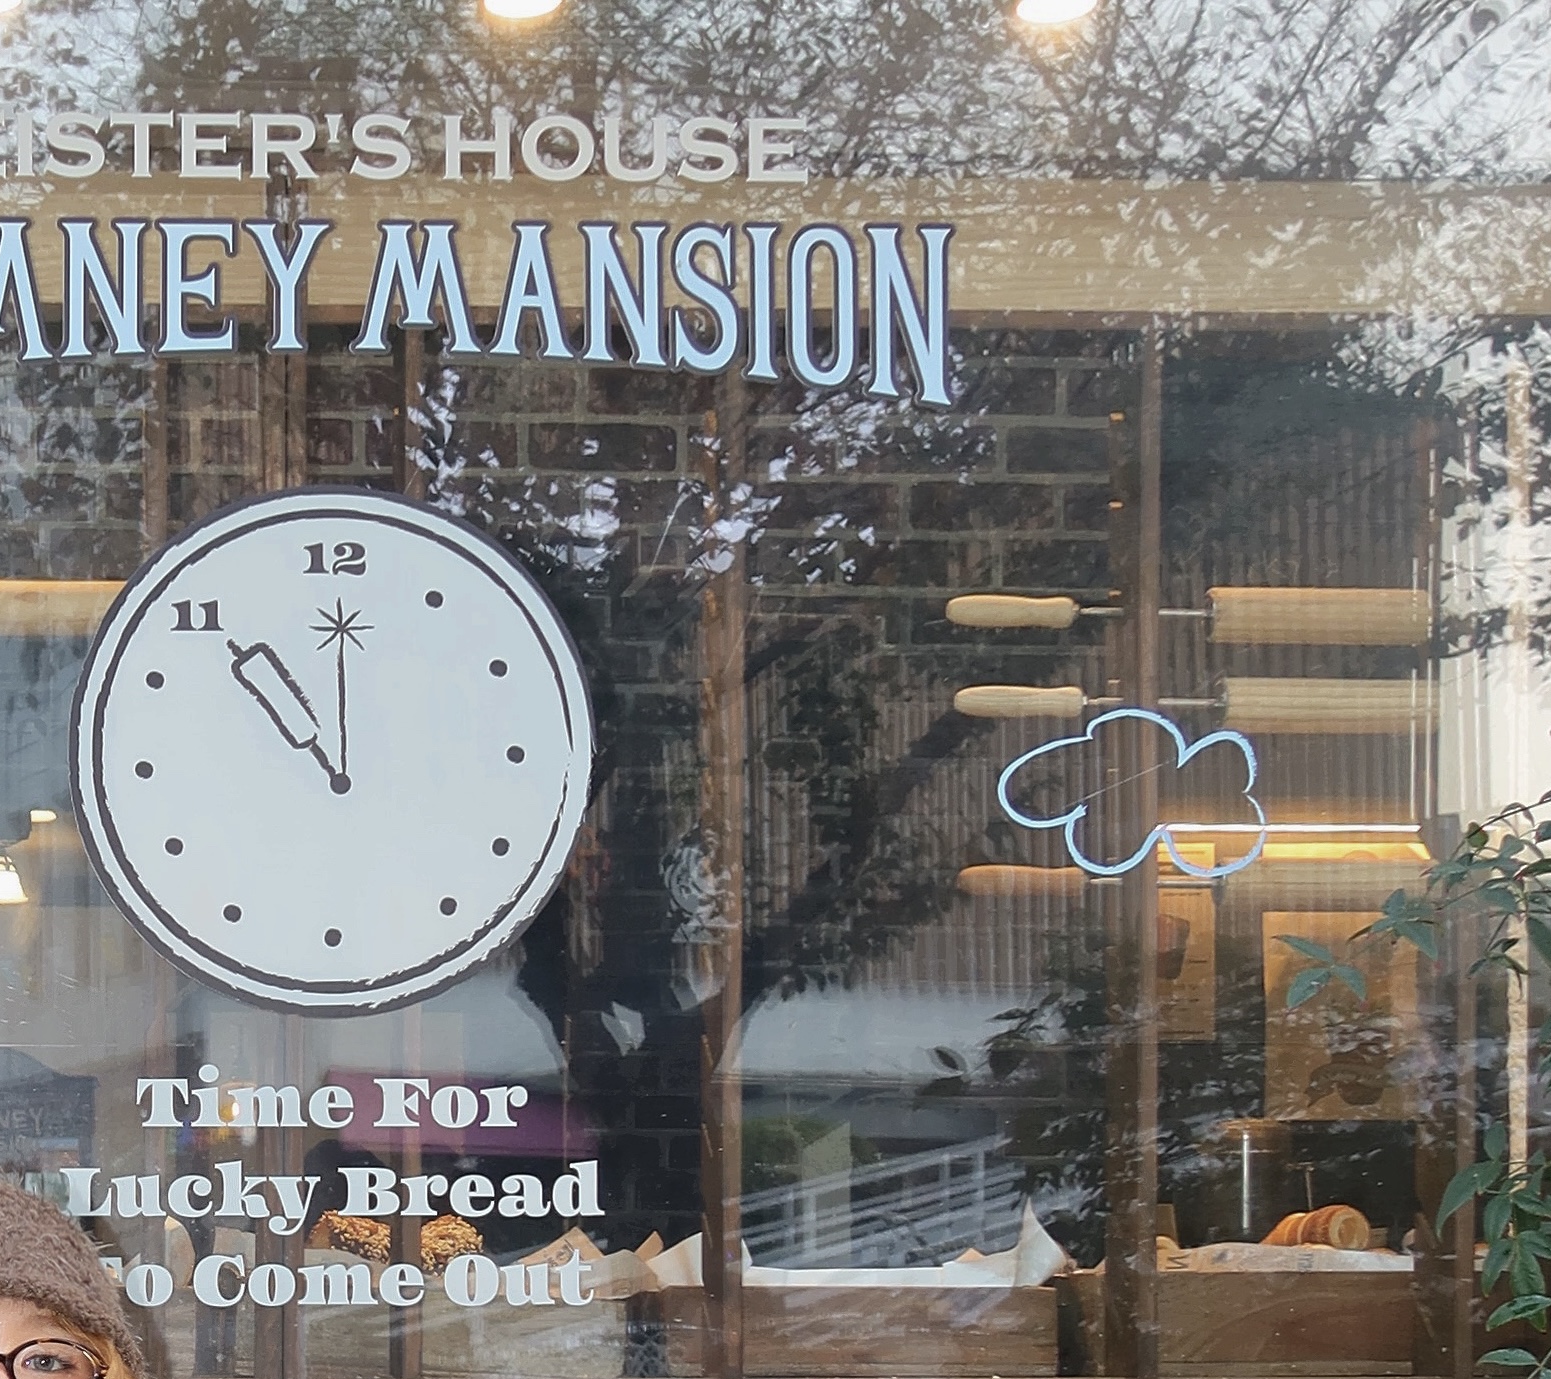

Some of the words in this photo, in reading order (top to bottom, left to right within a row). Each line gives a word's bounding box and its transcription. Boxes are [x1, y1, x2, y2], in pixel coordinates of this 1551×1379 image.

[443, 114, 809, 186] HOUSE
[351, 217, 955, 408] MANSION
[301, 541, 367, 576] 12
[170, 599, 225, 633] 11
[135, 1063, 355, 1130] Time
[372, 1077, 529, 1129] For
[59, 1160, 321, 1237] Lucky
[337, 1159, 606, 1218] Bread
[193, 1253, 425, 1308] Come
[443, 1246, 595, 1308] Out
